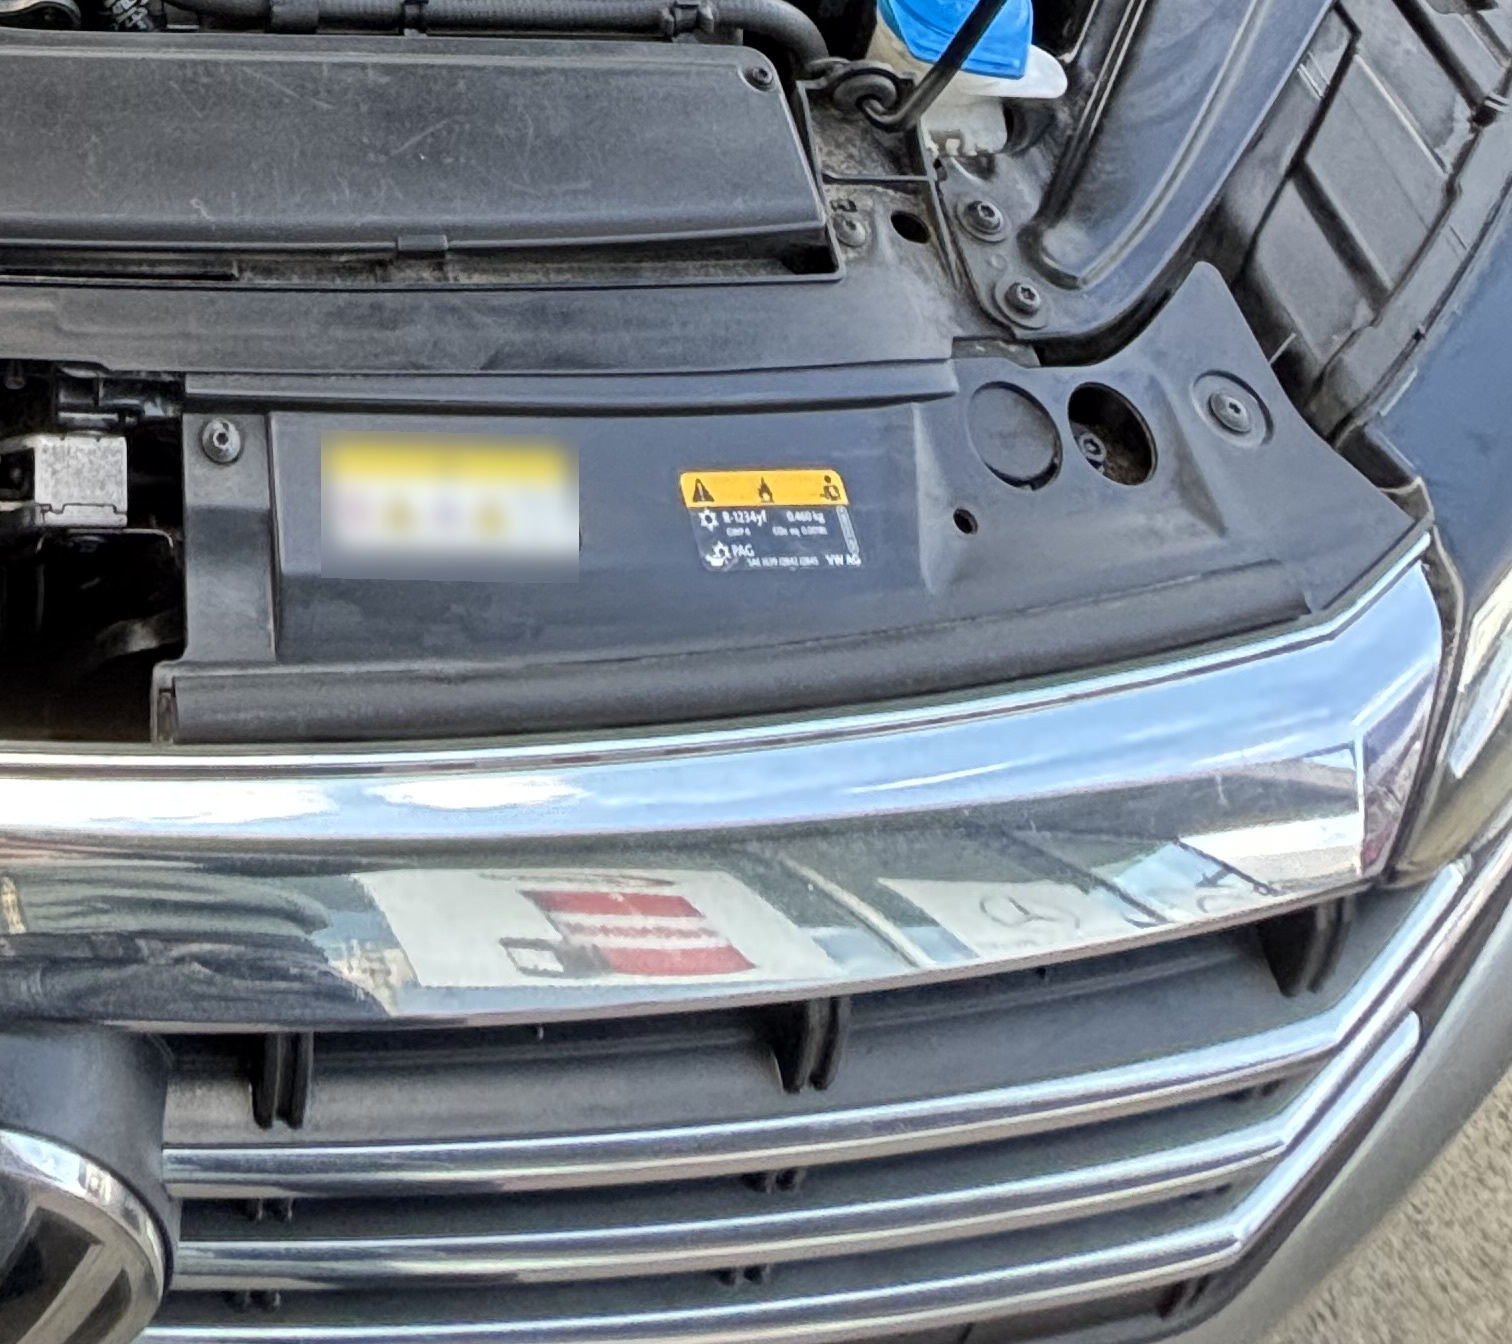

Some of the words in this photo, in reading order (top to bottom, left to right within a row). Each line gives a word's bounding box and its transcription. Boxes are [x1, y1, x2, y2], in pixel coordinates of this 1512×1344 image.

[722, 509, 767, 527] R-1234yf
[731, 543, 755, 558] PAG
[825, 554, 844, 567] VW
[846, 554, 862, 566] AG
